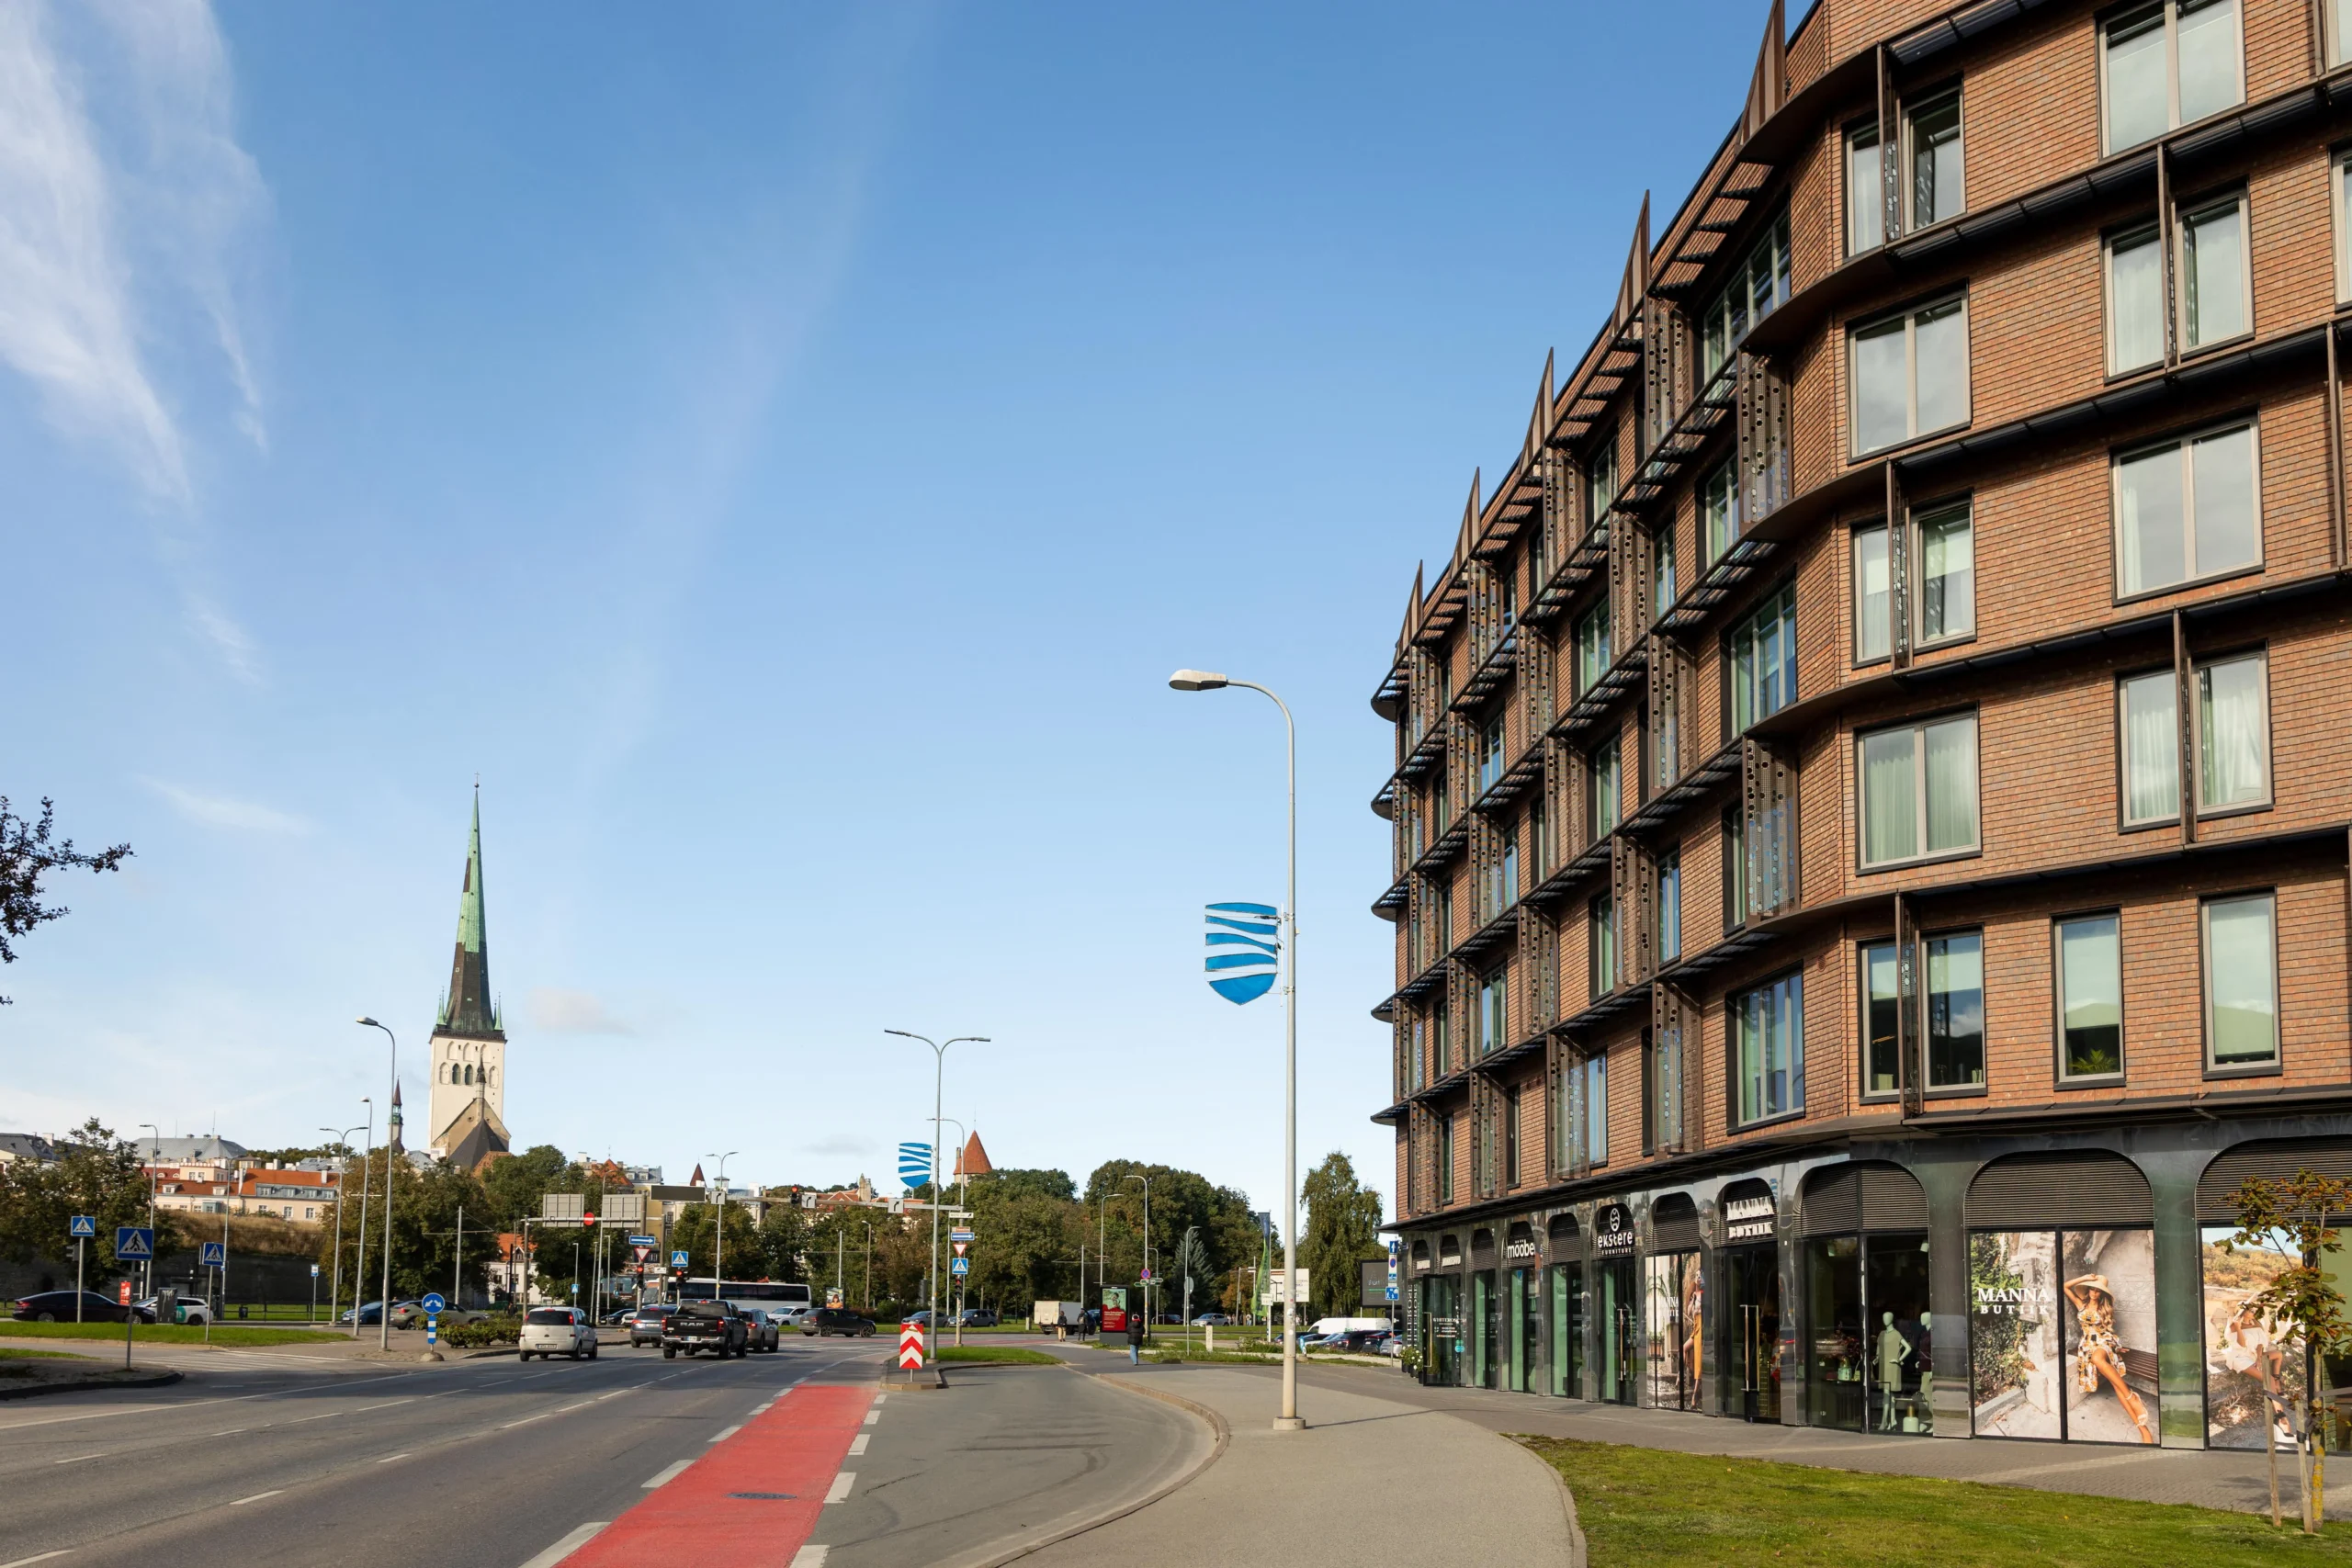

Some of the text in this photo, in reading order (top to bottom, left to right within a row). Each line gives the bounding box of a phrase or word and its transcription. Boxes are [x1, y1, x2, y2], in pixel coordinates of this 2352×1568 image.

[1726, 1195, 1775, 1221] MANNA
[1728, 1222, 1773, 1238] BUTIIK
[1598, 1232, 1633, 1248] ekstere
[1601, 1247, 1632, 1256] FURNITURE
[1976, 1288, 2052, 1303] MANNA
[1980, 1304, 2049, 1314] BUTIIK
